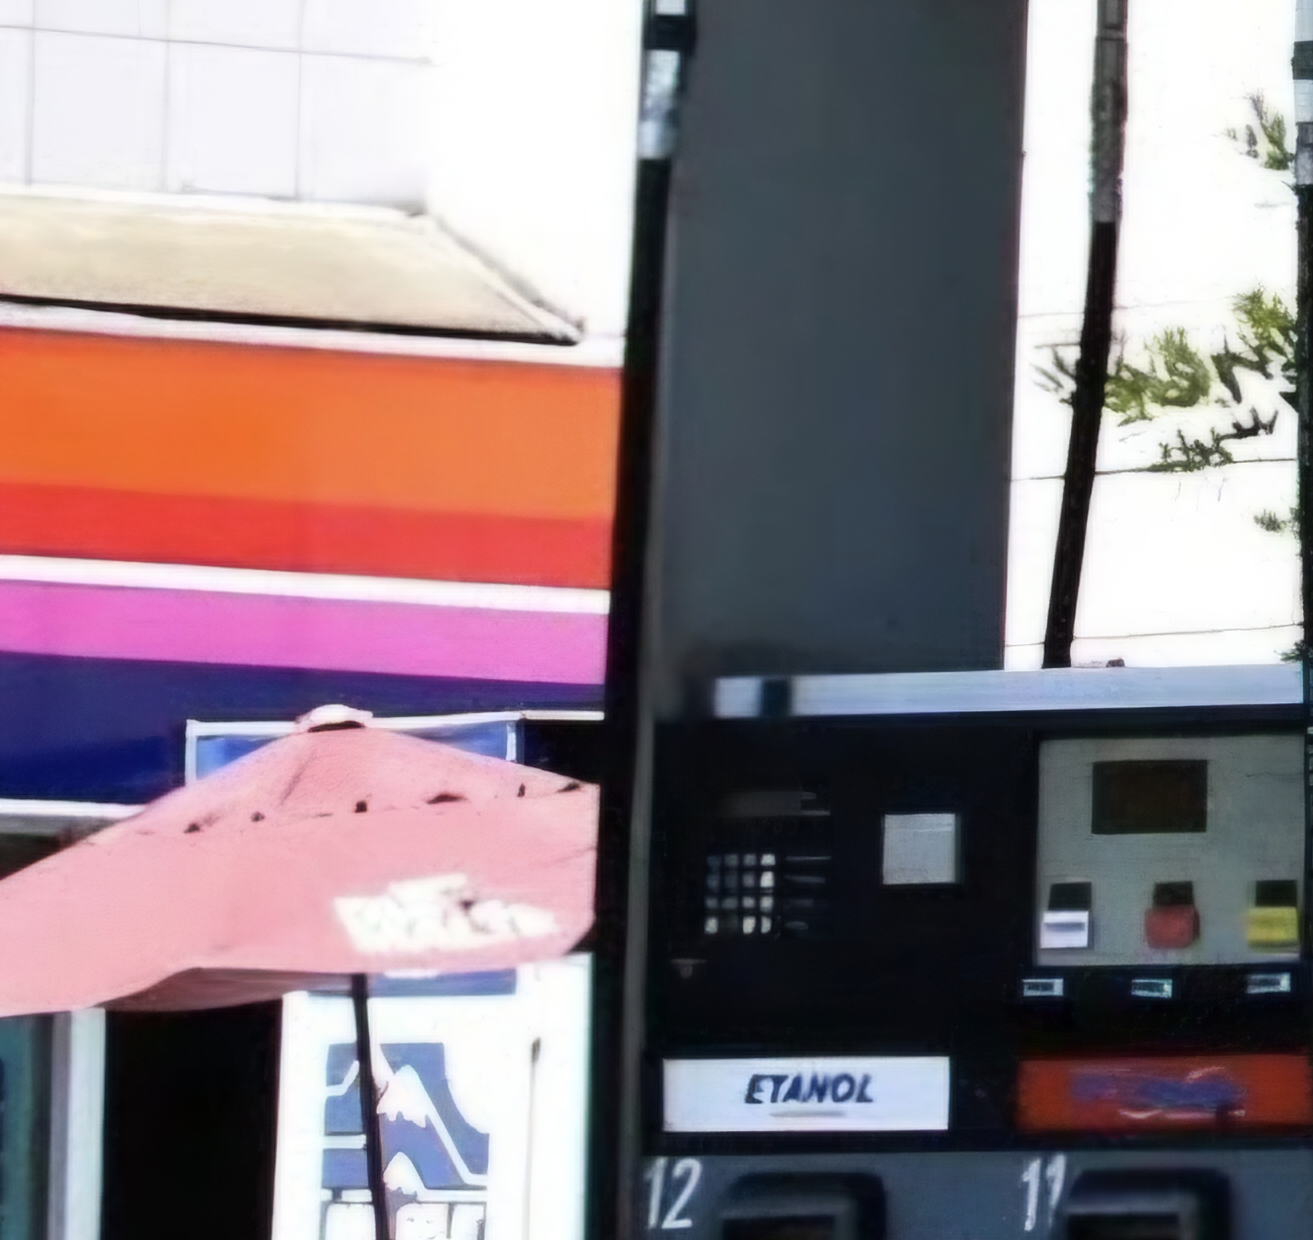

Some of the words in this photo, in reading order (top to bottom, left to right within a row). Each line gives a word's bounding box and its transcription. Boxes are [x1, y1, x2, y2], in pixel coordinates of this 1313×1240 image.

[744, 1072, 874, 1105] ETANOL
[643, 1156, 703, 1231] 12
[1021, 1153, 1067, 1232] 11
